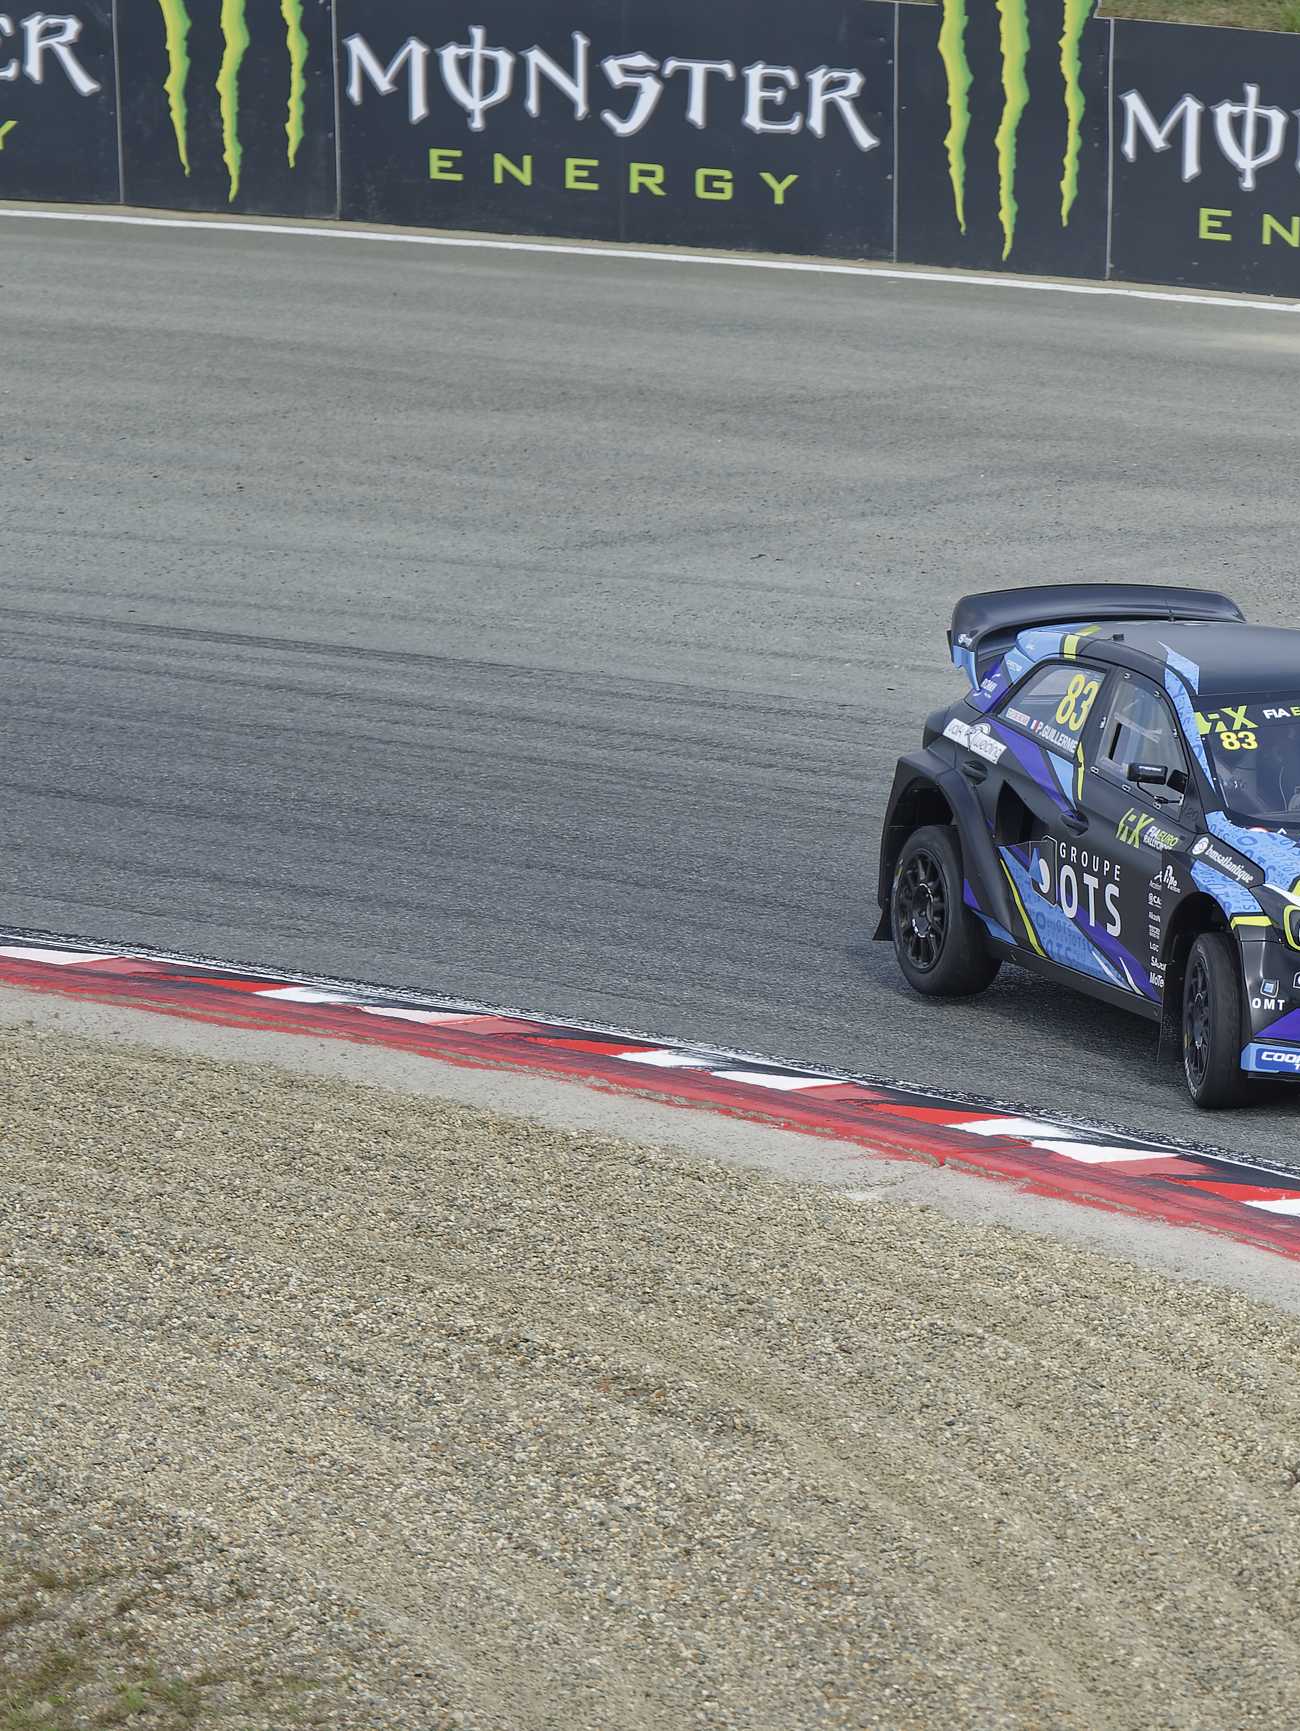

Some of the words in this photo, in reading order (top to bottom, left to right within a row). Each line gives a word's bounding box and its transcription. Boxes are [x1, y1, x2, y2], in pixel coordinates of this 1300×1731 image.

[342, 25, 880, 152] MONSTER
[429, 148, 799, 205] ENERGY
[1056, 674, 1099, 731] 83
[1263, 708, 1290, 719] FIA
[1220, 731, 1258, 750] 83
[1060, 842, 1120, 881] GROUPE
[1060, 865, 1121, 937] OTS
[1252, 997, 1286, 1011] OMT
